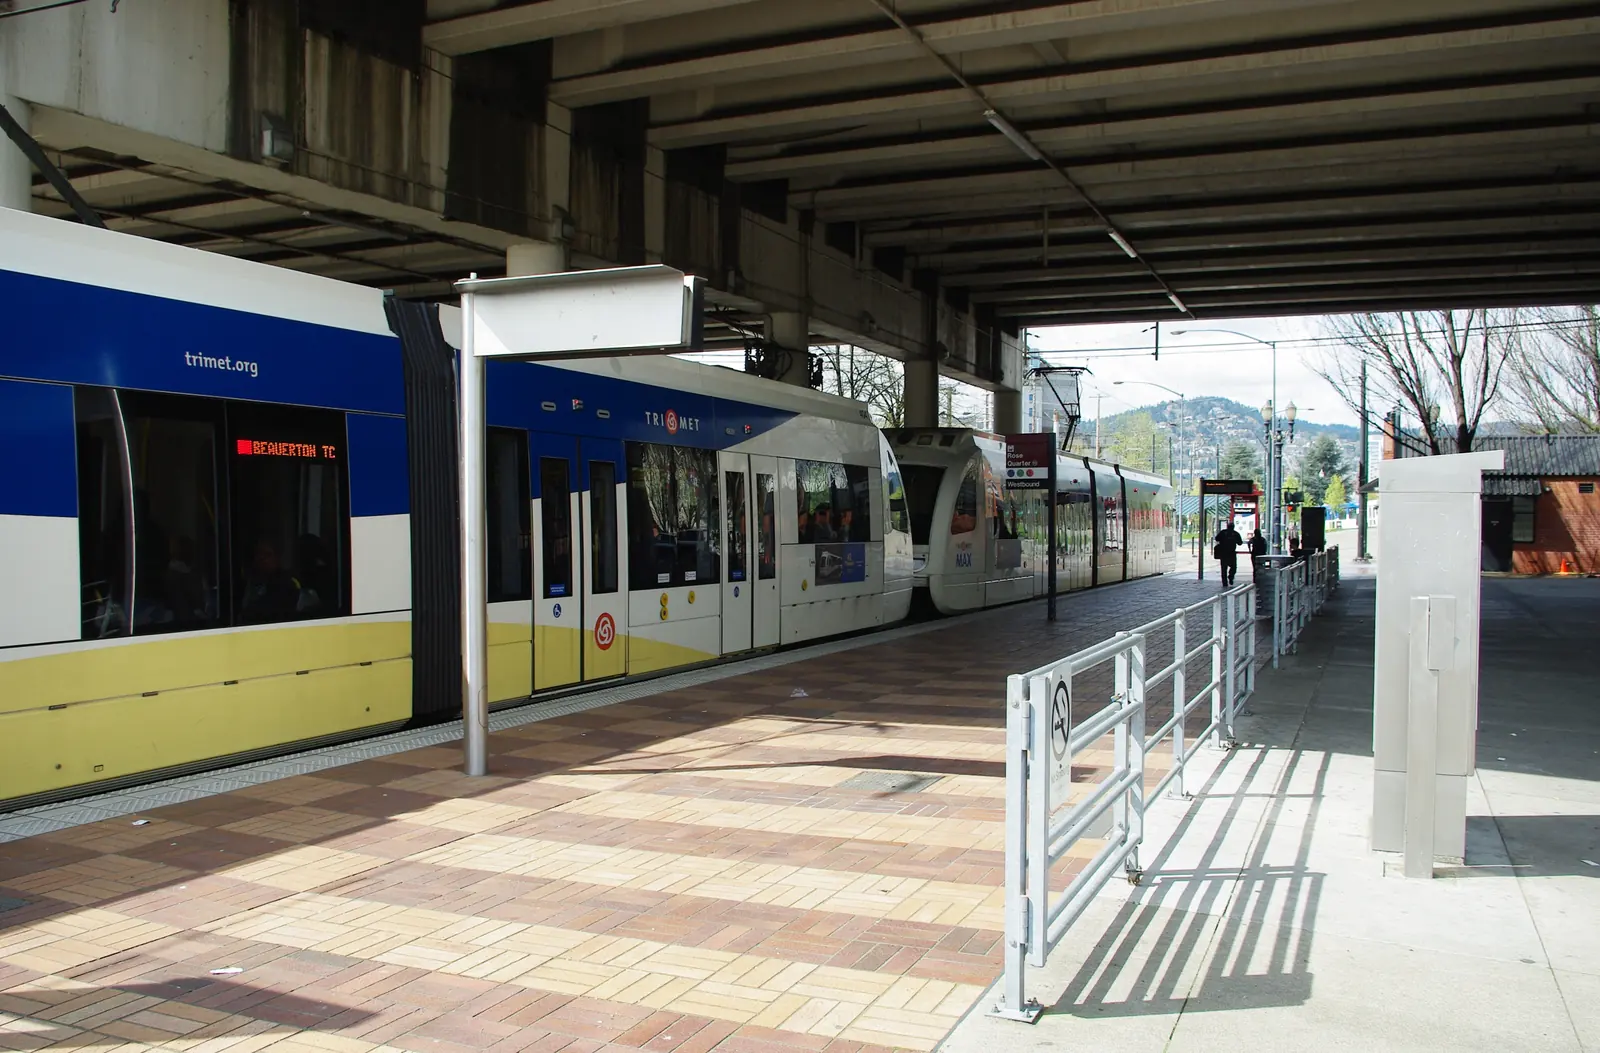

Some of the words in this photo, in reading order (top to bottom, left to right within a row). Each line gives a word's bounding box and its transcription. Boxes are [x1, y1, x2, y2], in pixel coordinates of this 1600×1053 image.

[184, 351, 259, 378] trimet.org
[252, 440, 317, 458] BEAVERTON
[322, 445, 336, 459] TC
[1007, 480, 1040, 488] Westbound
[955, 552, 972, 567] MAX
